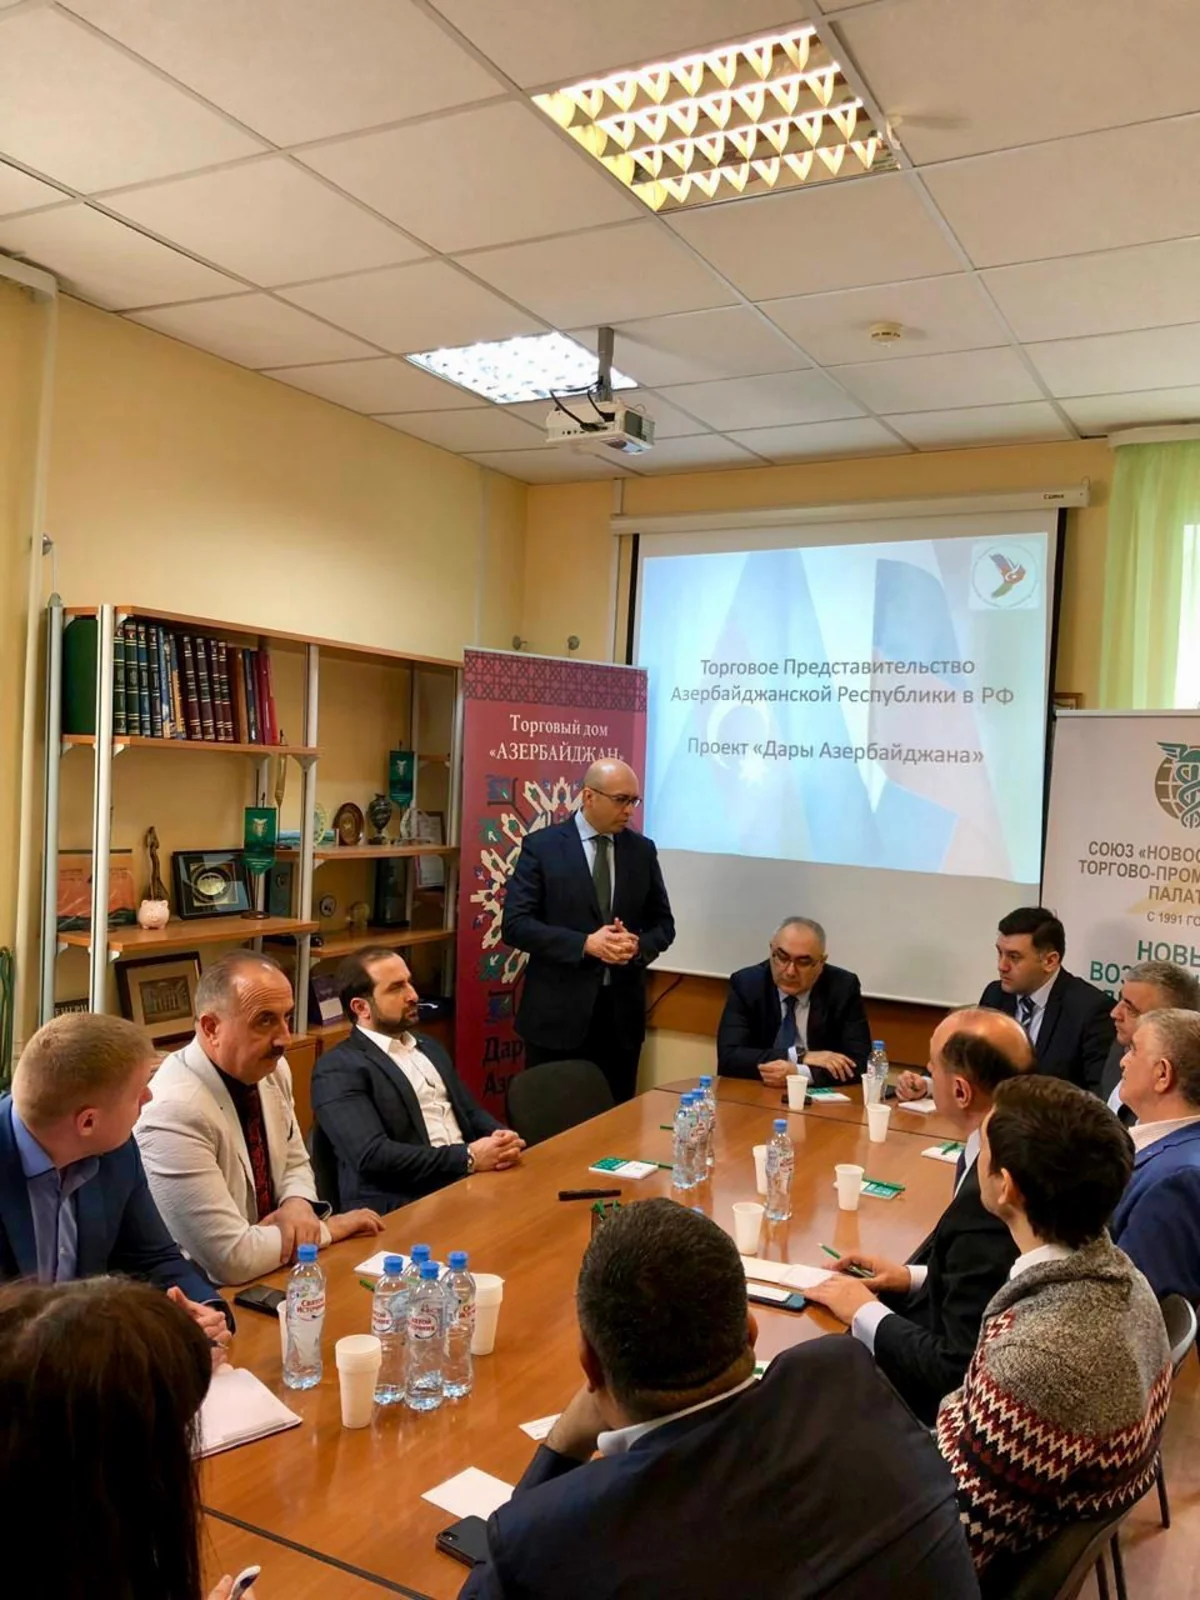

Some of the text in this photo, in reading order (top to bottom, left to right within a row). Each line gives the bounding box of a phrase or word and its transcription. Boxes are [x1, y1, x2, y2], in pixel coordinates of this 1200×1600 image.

[701, 658, 975, 678] Торговое Представительство
[671, 685, 1014, 706] Азербайджанской Республики в РФ
[509, 714, 608, 737] Торговый дом
[688, 737, 984, 765] Проект «Дары Азербайджана»
[1088, 841, 1134, 858] СОЮЗ
[1079, 860, 1200, 884] ТОРГОВО-ПРОМ
[1147, 911, 1155, 922] С
[1159, 912, 1182, 925] 1991
